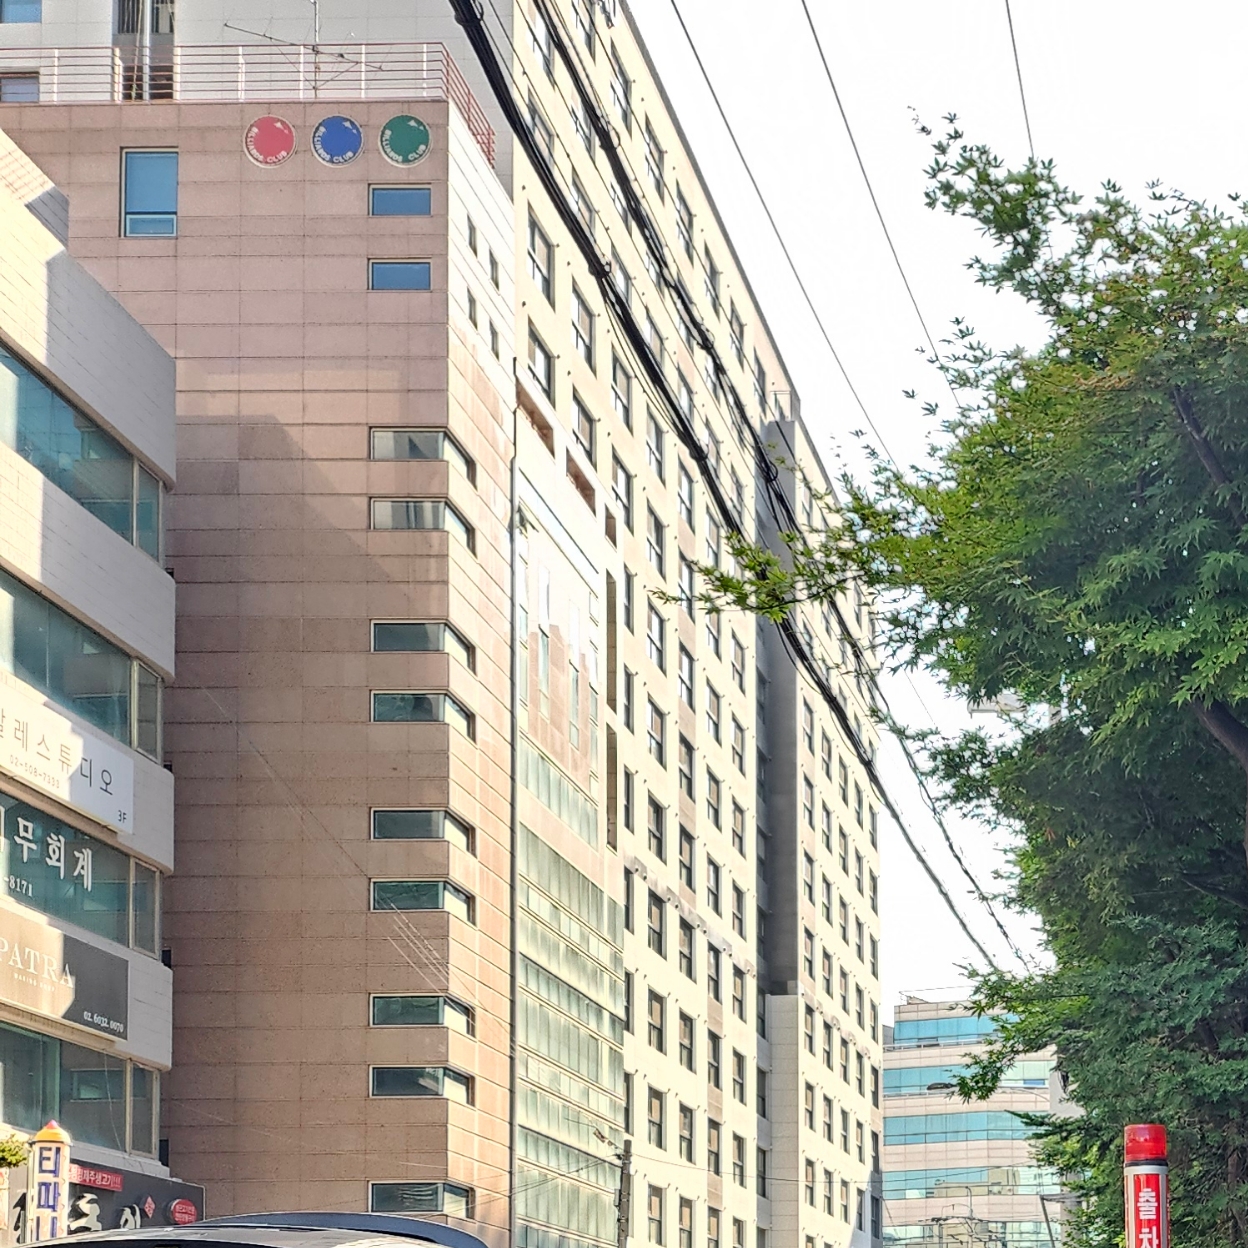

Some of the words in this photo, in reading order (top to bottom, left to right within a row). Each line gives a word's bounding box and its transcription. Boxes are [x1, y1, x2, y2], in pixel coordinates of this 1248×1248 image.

[266, 150, 288, 164] CLUB
[333, 150, 354, 164] CLUB
[408, 144, 427, 161] CLUB
[117, 809, 128, 824] 3F
[0, 805, 92, 892] 무회계
